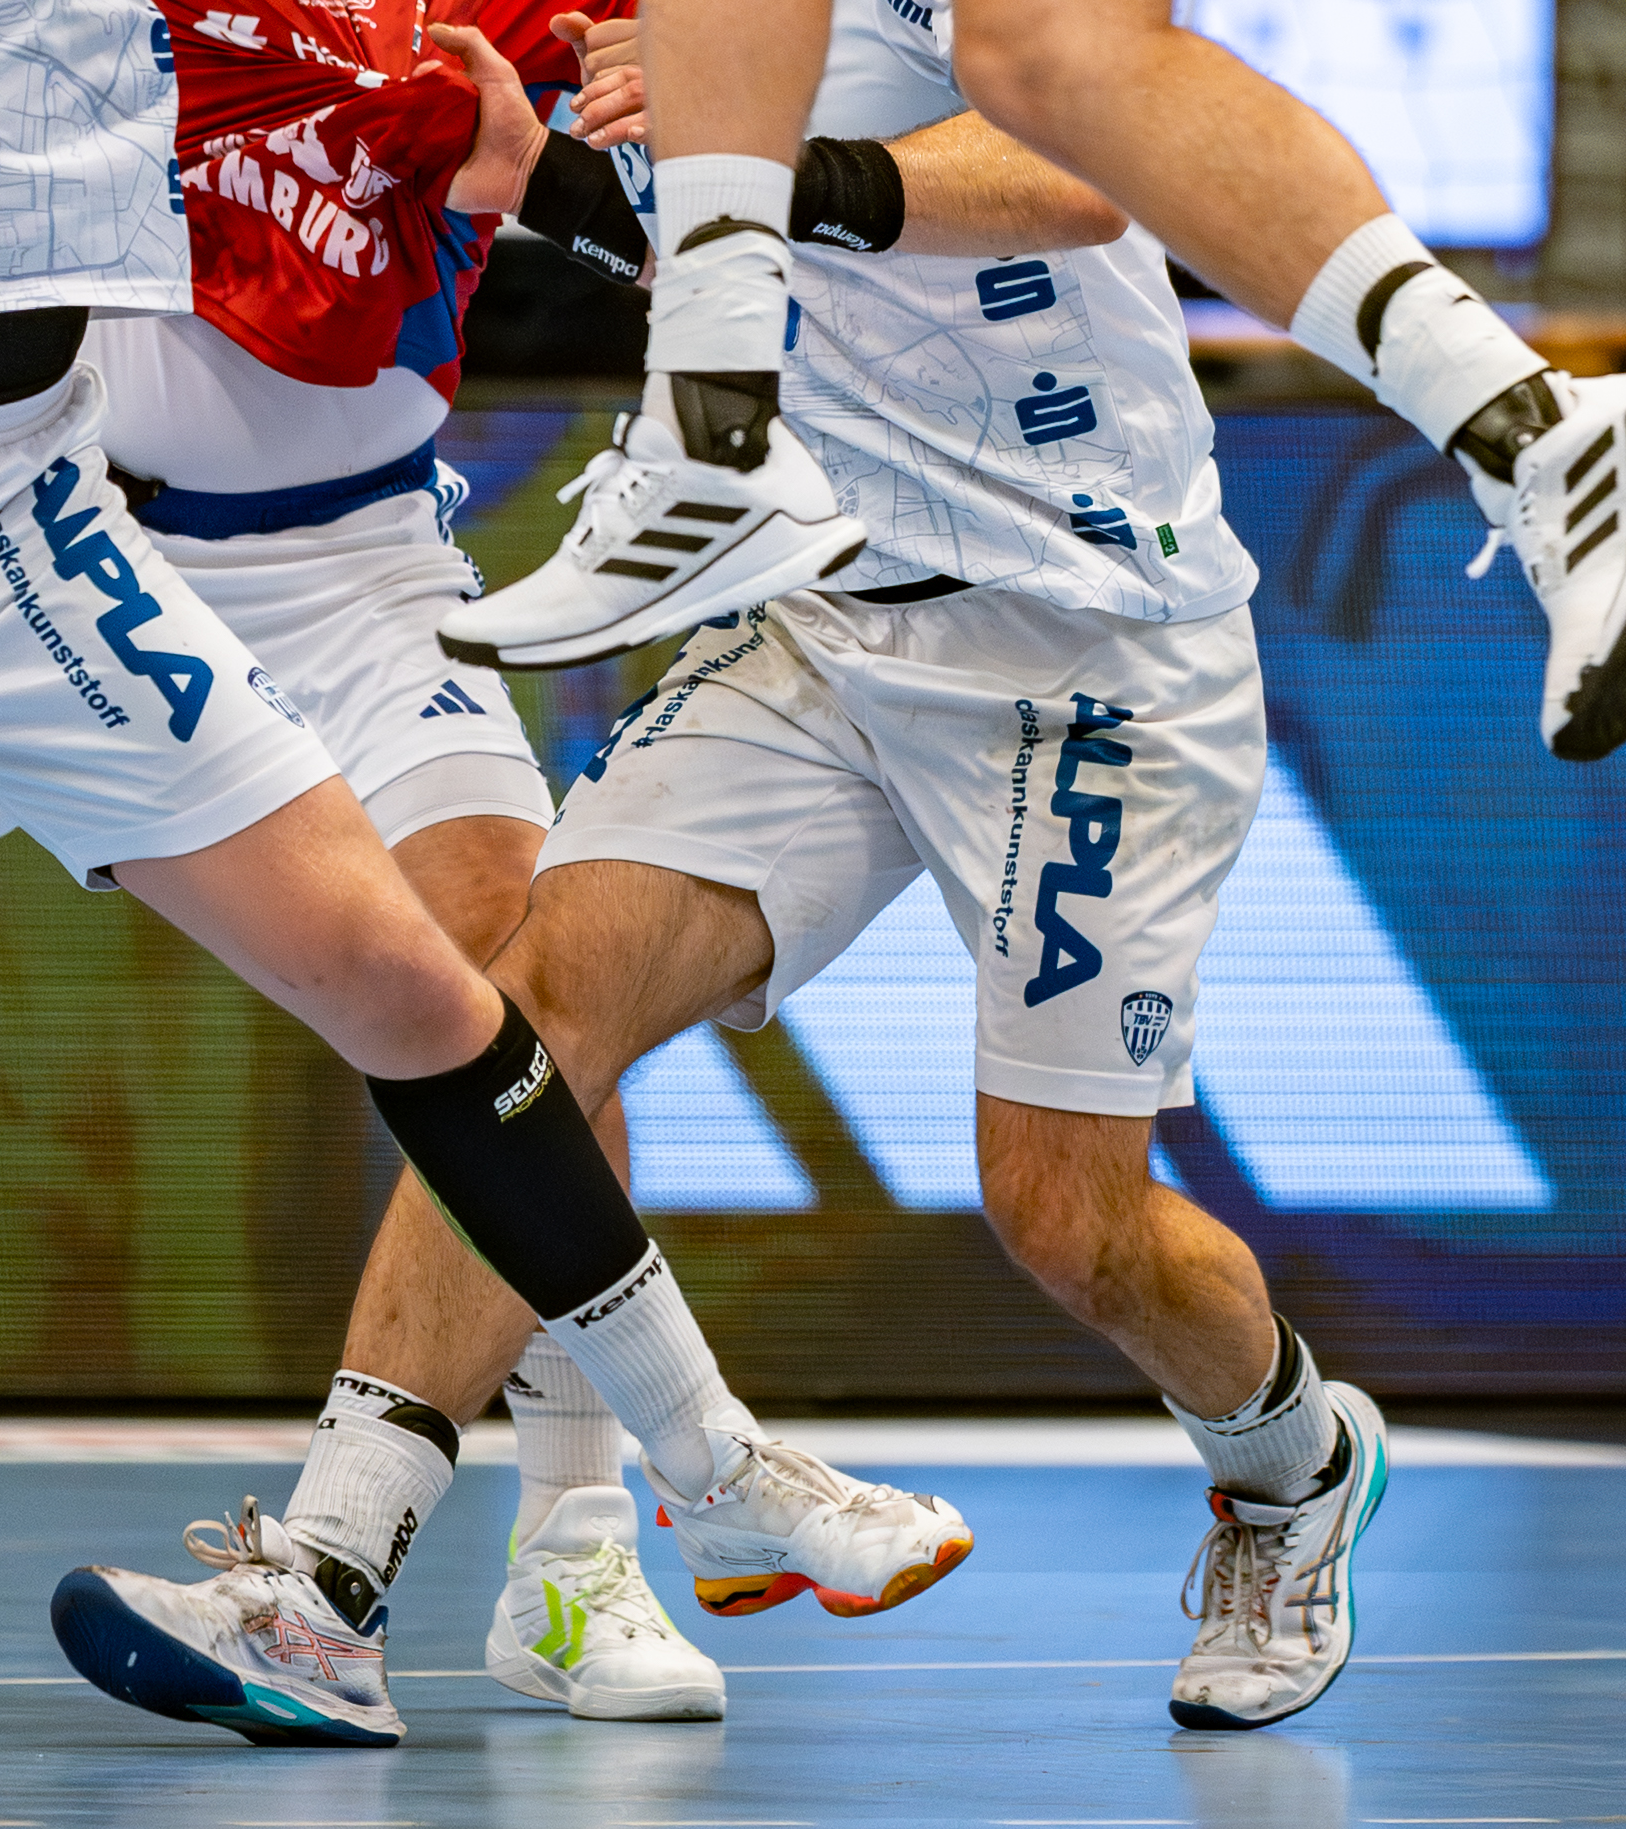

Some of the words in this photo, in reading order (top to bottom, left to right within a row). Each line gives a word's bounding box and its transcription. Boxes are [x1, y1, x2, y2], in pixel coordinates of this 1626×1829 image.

[572, 235, 639, 278] Kempa
[812, 221, 873, 251] Kempa
[1024, 691, 1134, 1009] ALPLA
[572, 1253, 662, 1330] Kemp
[383, 1506, 419, 1589] empa
